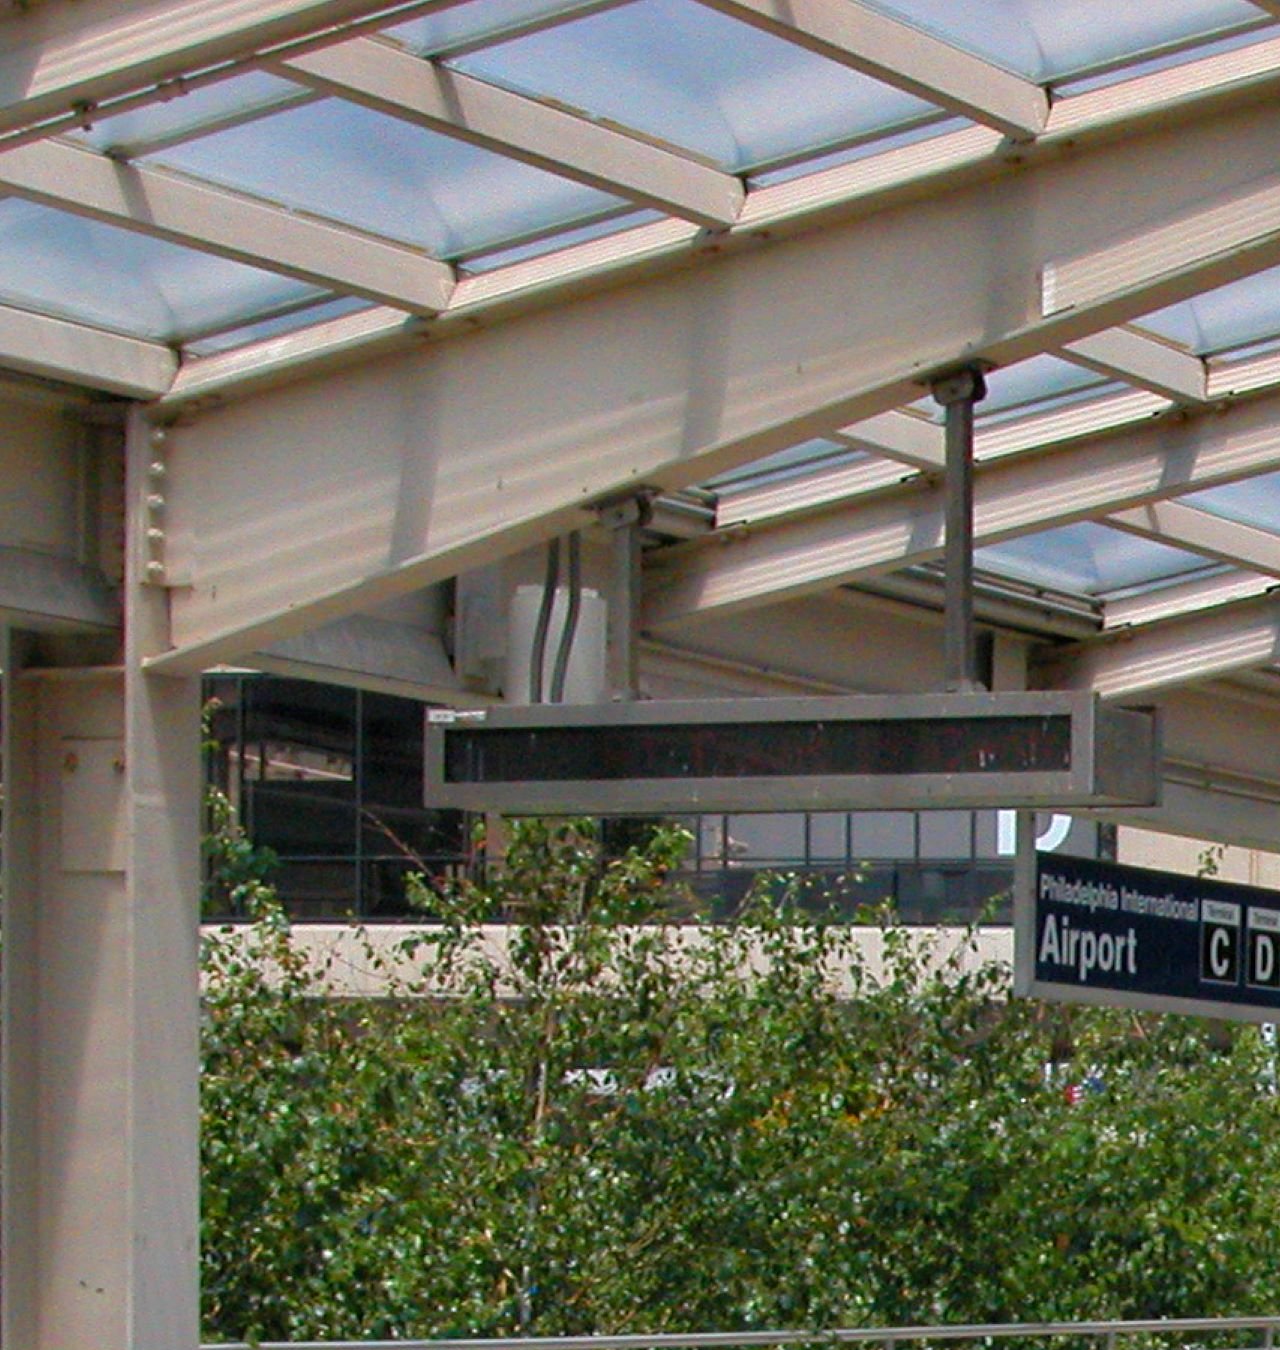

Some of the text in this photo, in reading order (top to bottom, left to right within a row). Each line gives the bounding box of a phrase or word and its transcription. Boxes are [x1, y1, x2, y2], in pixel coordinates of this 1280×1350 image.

[1040, 873, 1199, 921] Philadelphia International
[1039, 913, 1138, 981] Airport
[1210, 927, 1231, 977] C
[1255, 934, 1274, 981] D
